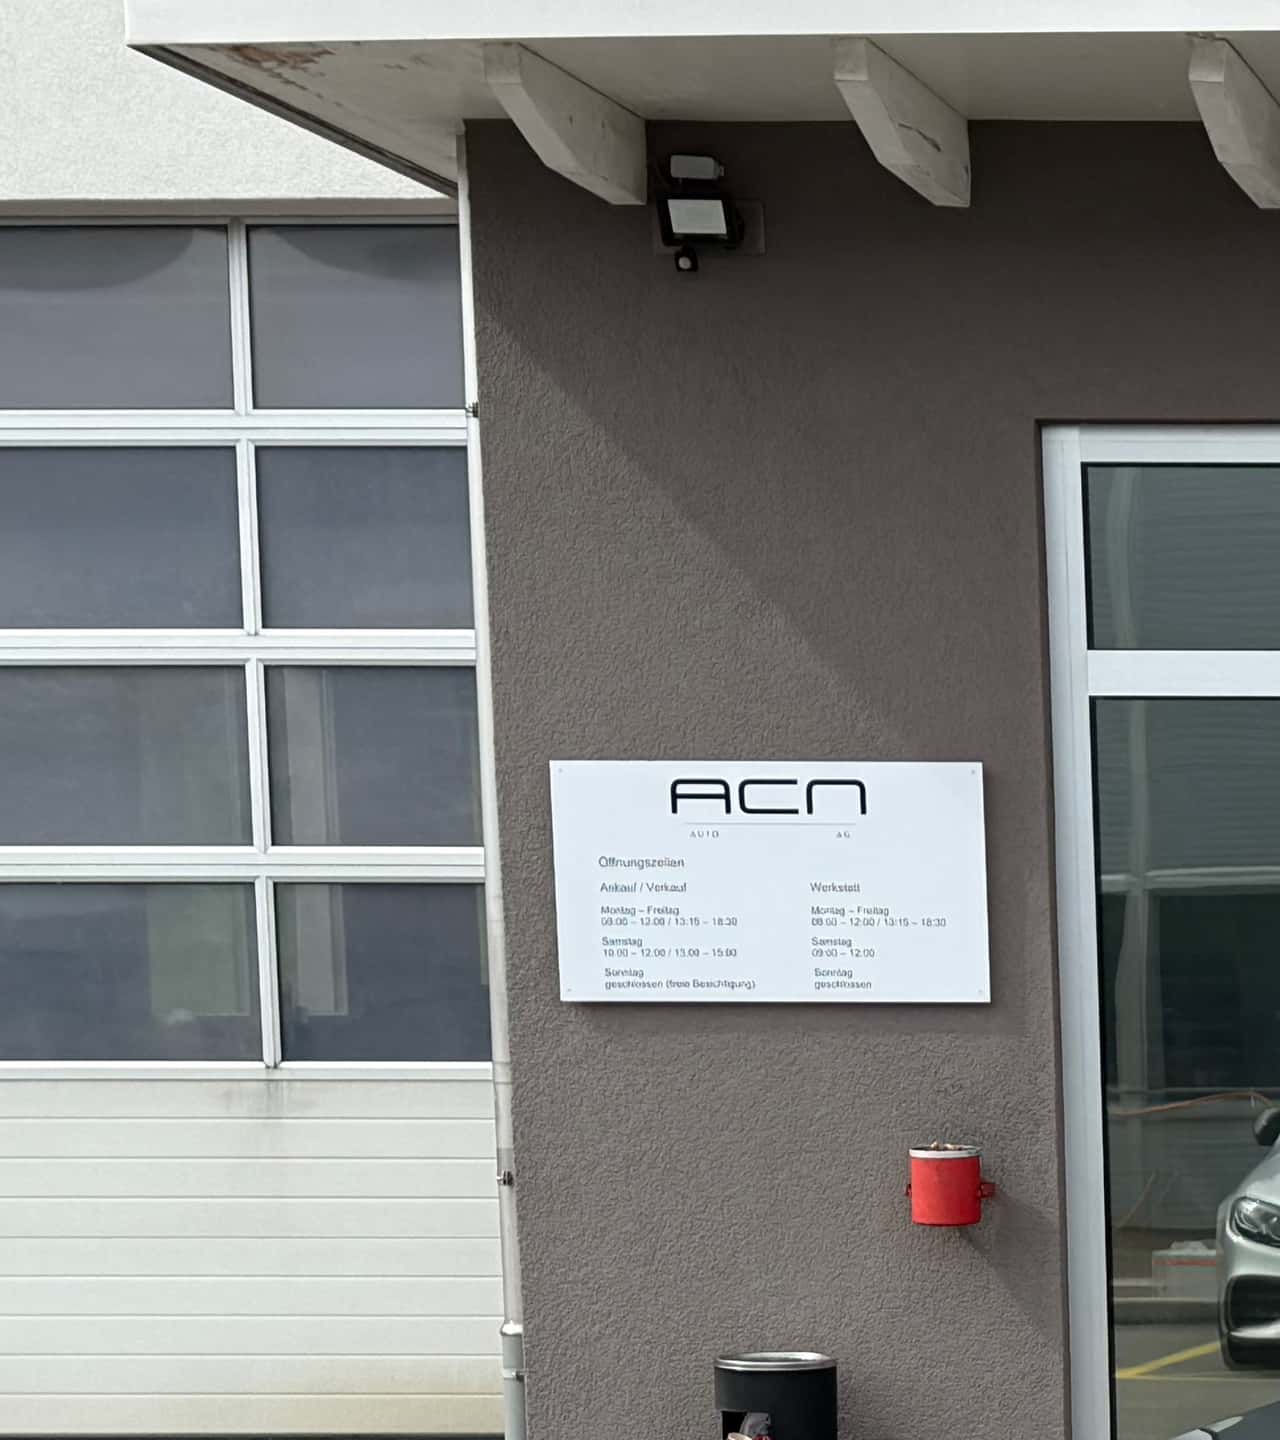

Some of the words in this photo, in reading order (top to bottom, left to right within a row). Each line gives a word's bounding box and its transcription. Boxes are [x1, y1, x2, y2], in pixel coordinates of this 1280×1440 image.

[670, 778, 867, 815] ACN
[600, 882, 636, 893] Ankauf
[646, 882, 687, 893] Verkauf
[810, 882, 861, 893] Werkstatt
[601, 906, 636, 917] Montag
[647, 906, 680, 917] Freitag
[811, 906, 846, 917] Montag
[857, 906, 889, 917] Freitag
[602, 936, 643, 947] Samstag
[811, 937, 852, 948] Samstag
[604, 967, 644, 978] Sonntag
[814, 968, 853, 979] Sonntag
[605, 979, 663, 990] geschlossen
[814, 980, 872, 991] geschlossen
